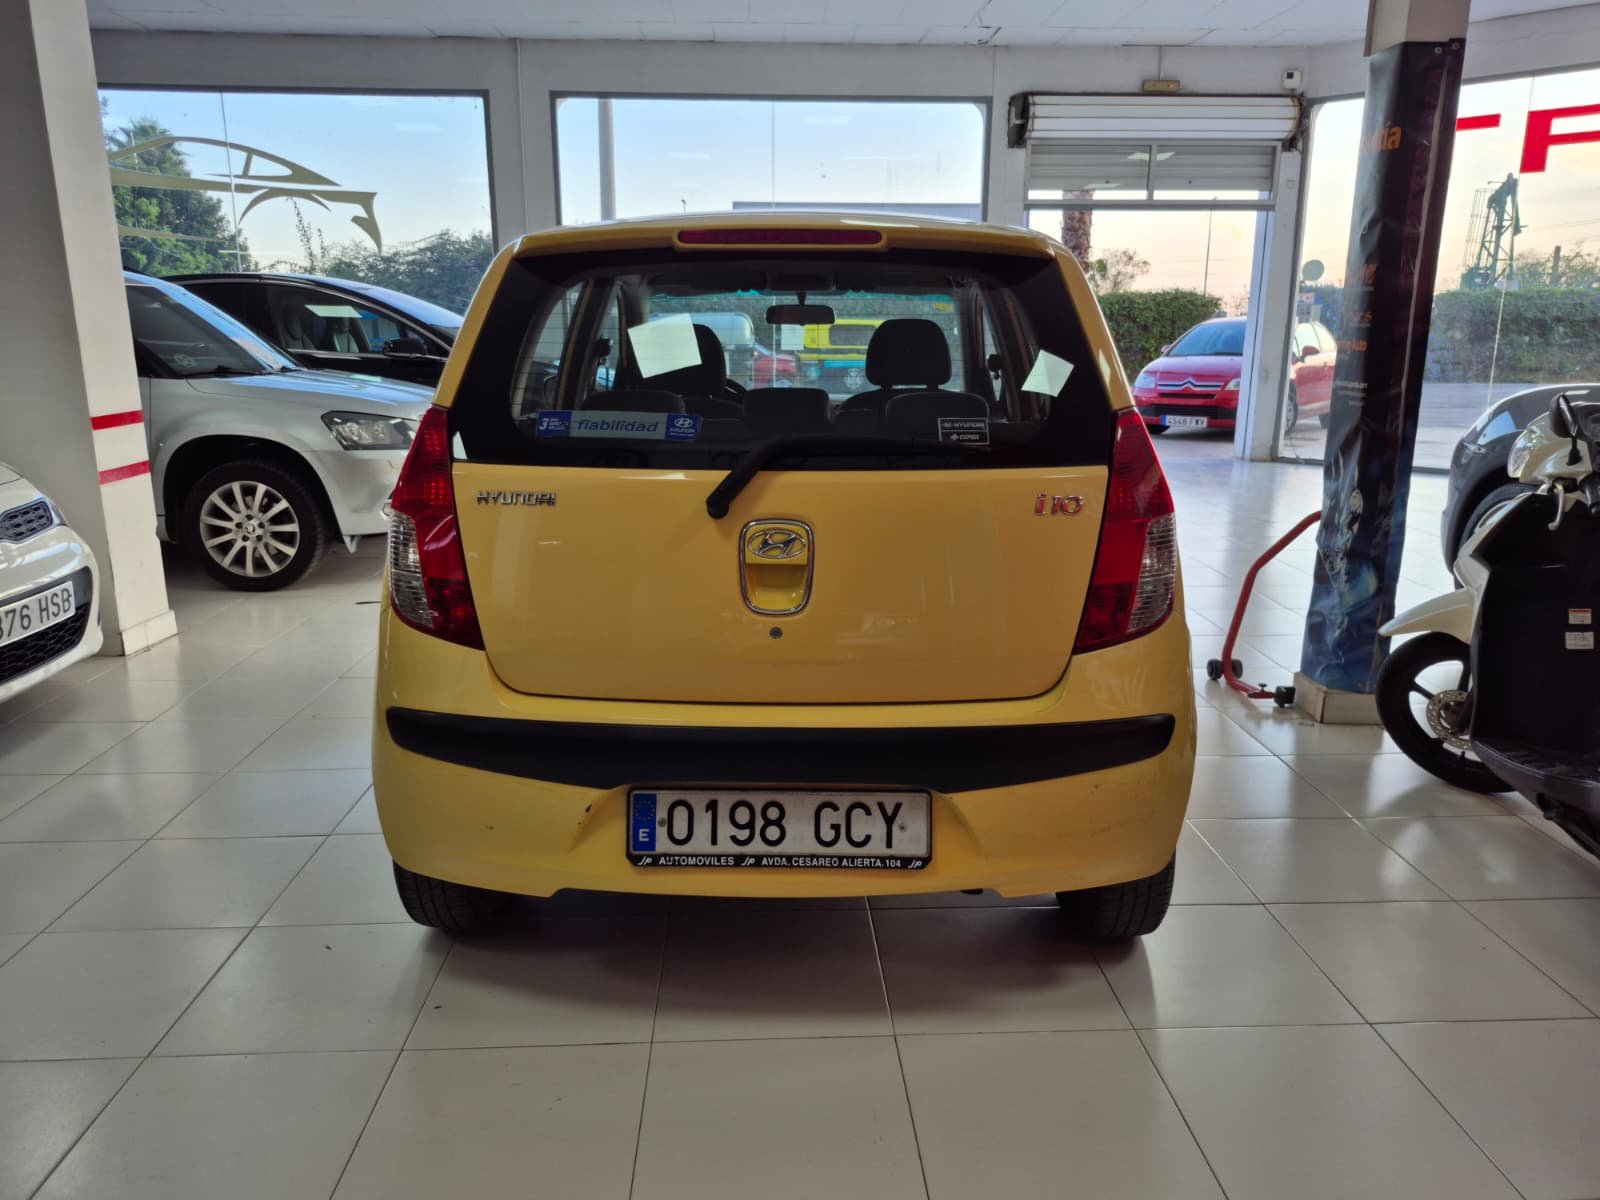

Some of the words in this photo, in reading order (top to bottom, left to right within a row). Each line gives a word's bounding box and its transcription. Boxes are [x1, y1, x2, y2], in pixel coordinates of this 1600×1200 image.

[577, 419, 659, 432] fiabilidad
[477, 490, 556, 506] HYUNDAI
[0, 605, 32, 640] 76
[39, 588, 72, 624] HSB
[666, 799, 787, 847] 0198
[813, 801, 904, 849] GCY
[638, 828, 650, 842] E
[659, 856, 735, 866] AUTOMOVILES
[761, 857, 791, 867] AVDA.
[792, 857, 840, 867] CESAREO
